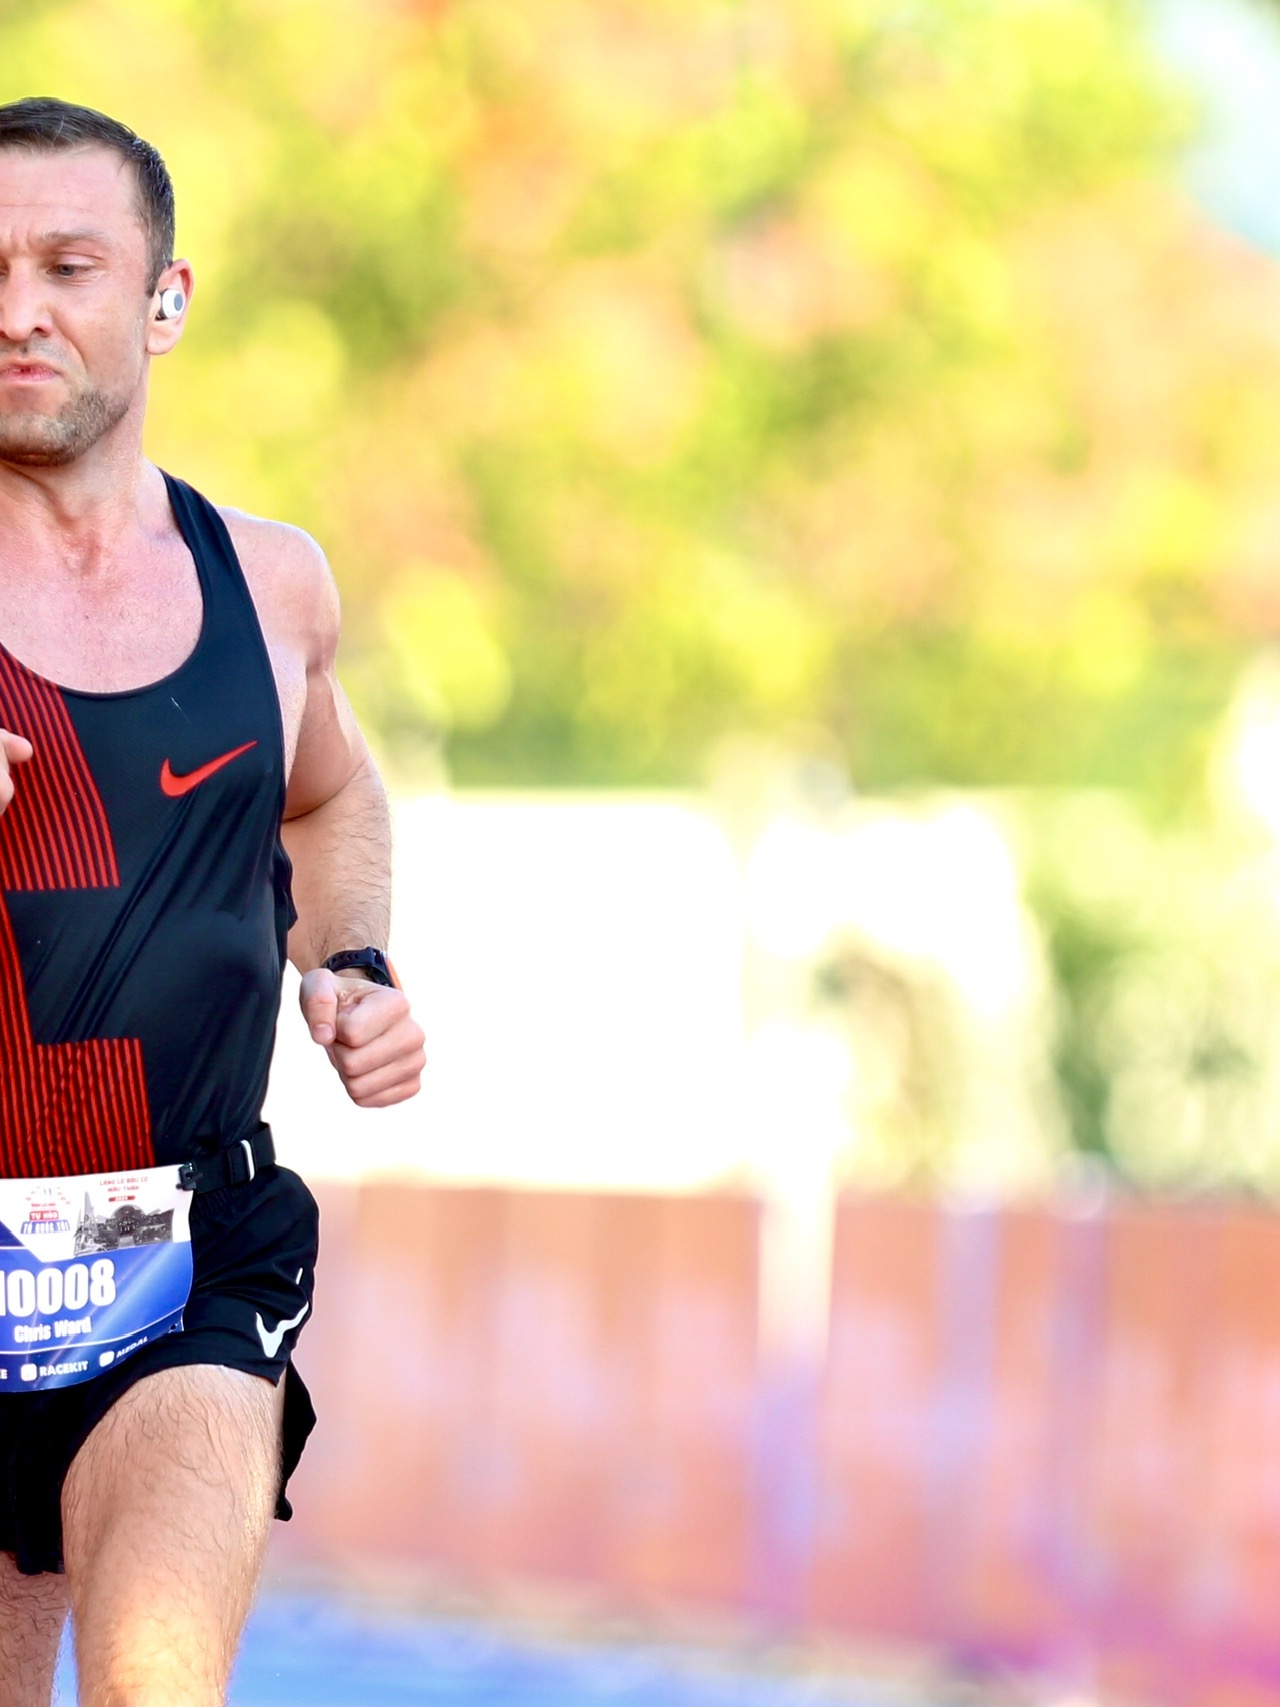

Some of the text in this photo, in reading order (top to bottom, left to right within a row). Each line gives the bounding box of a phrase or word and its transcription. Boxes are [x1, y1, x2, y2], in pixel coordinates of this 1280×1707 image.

[14, 1316, 92, 1343] Chris Ward
[116, 1336, 148, 1358] MEDAL
[39, 1360, 89, 1377] RACEKIT
